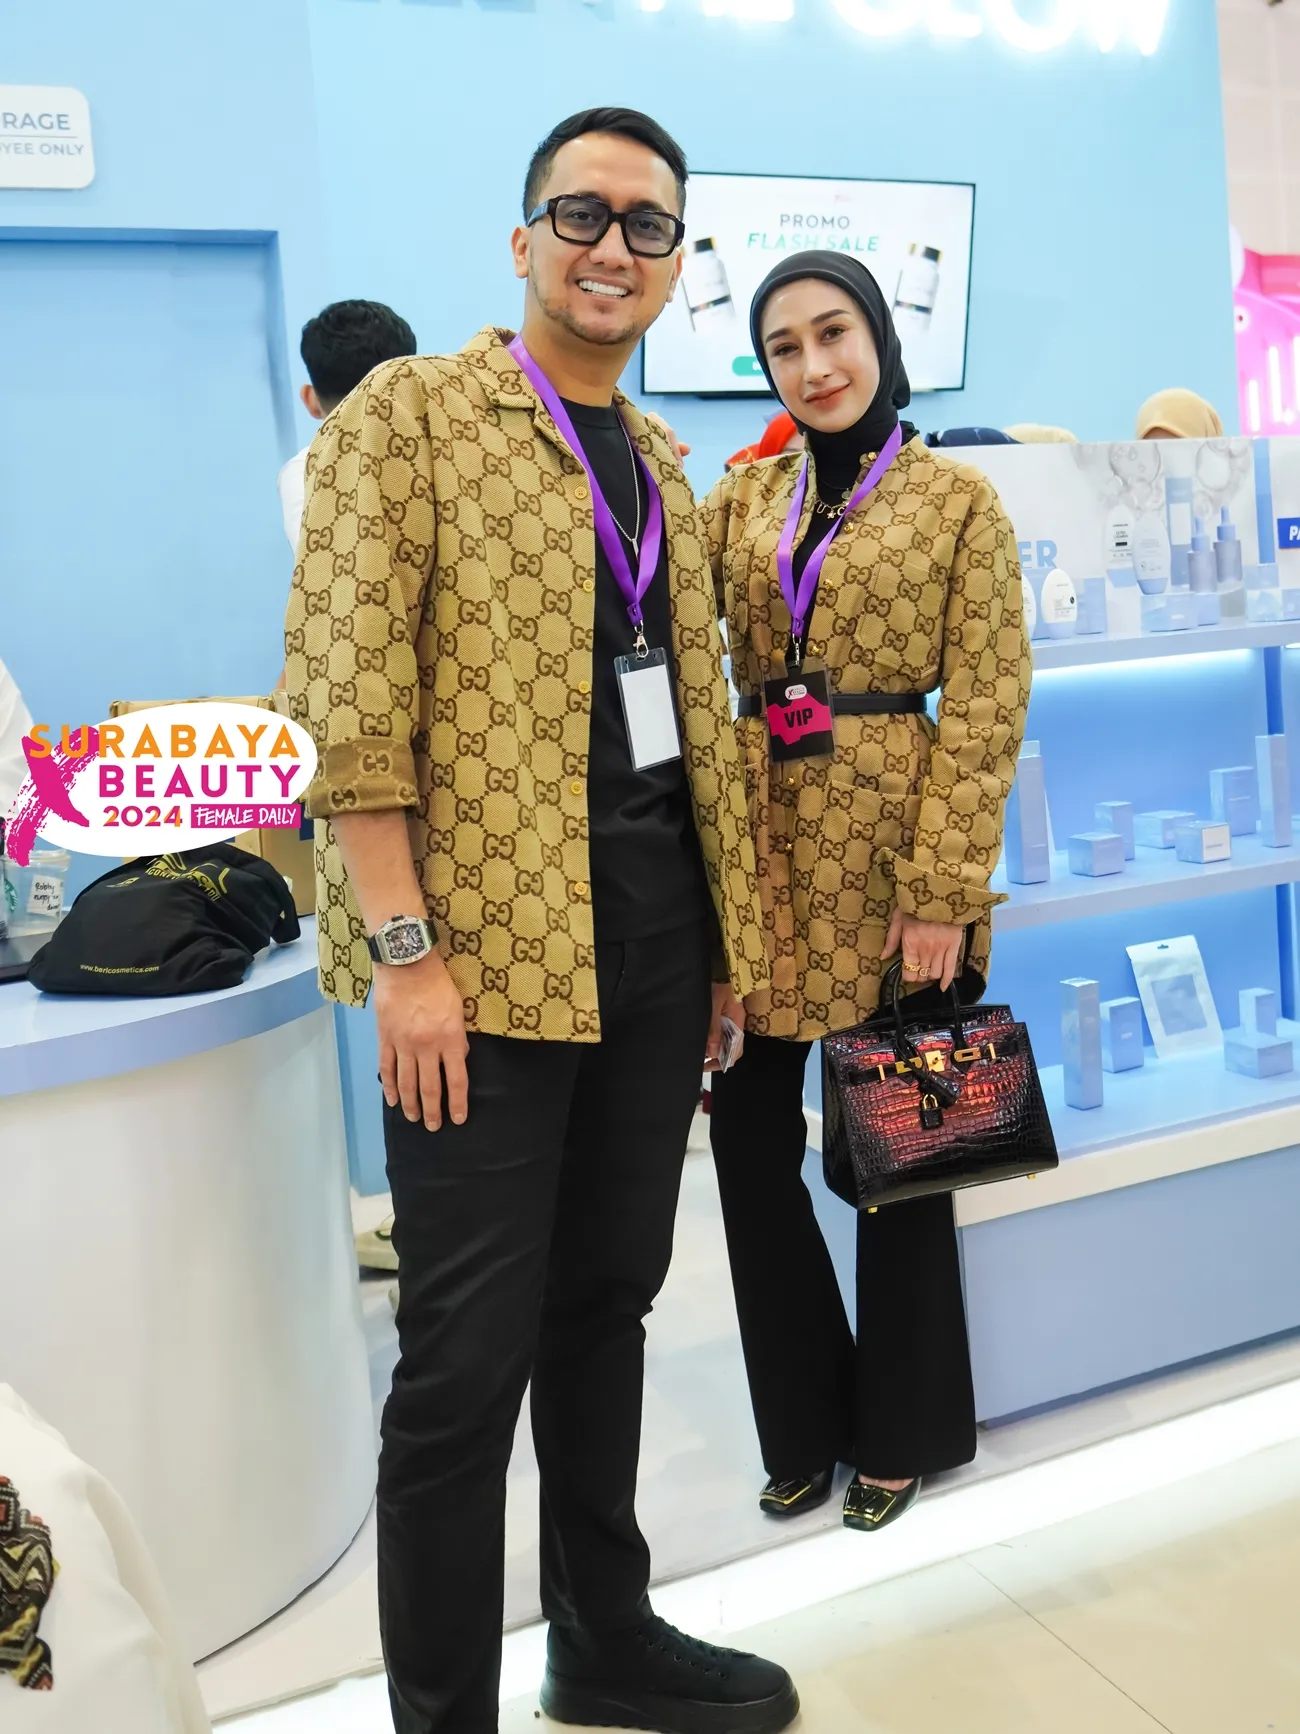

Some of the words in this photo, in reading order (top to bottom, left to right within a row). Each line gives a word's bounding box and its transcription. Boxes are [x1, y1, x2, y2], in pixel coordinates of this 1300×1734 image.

[2, 112, 71, 131] RAGE
[0, 142, 35, 155] YEE
[39, 143, 84, 156] ONLY
[779, 213, 850, 230] PROMO
[747, 232, 819, 250] FLASH
[826, 235, 880, 252] SALE
[784, 708, 813, 729] VIP
